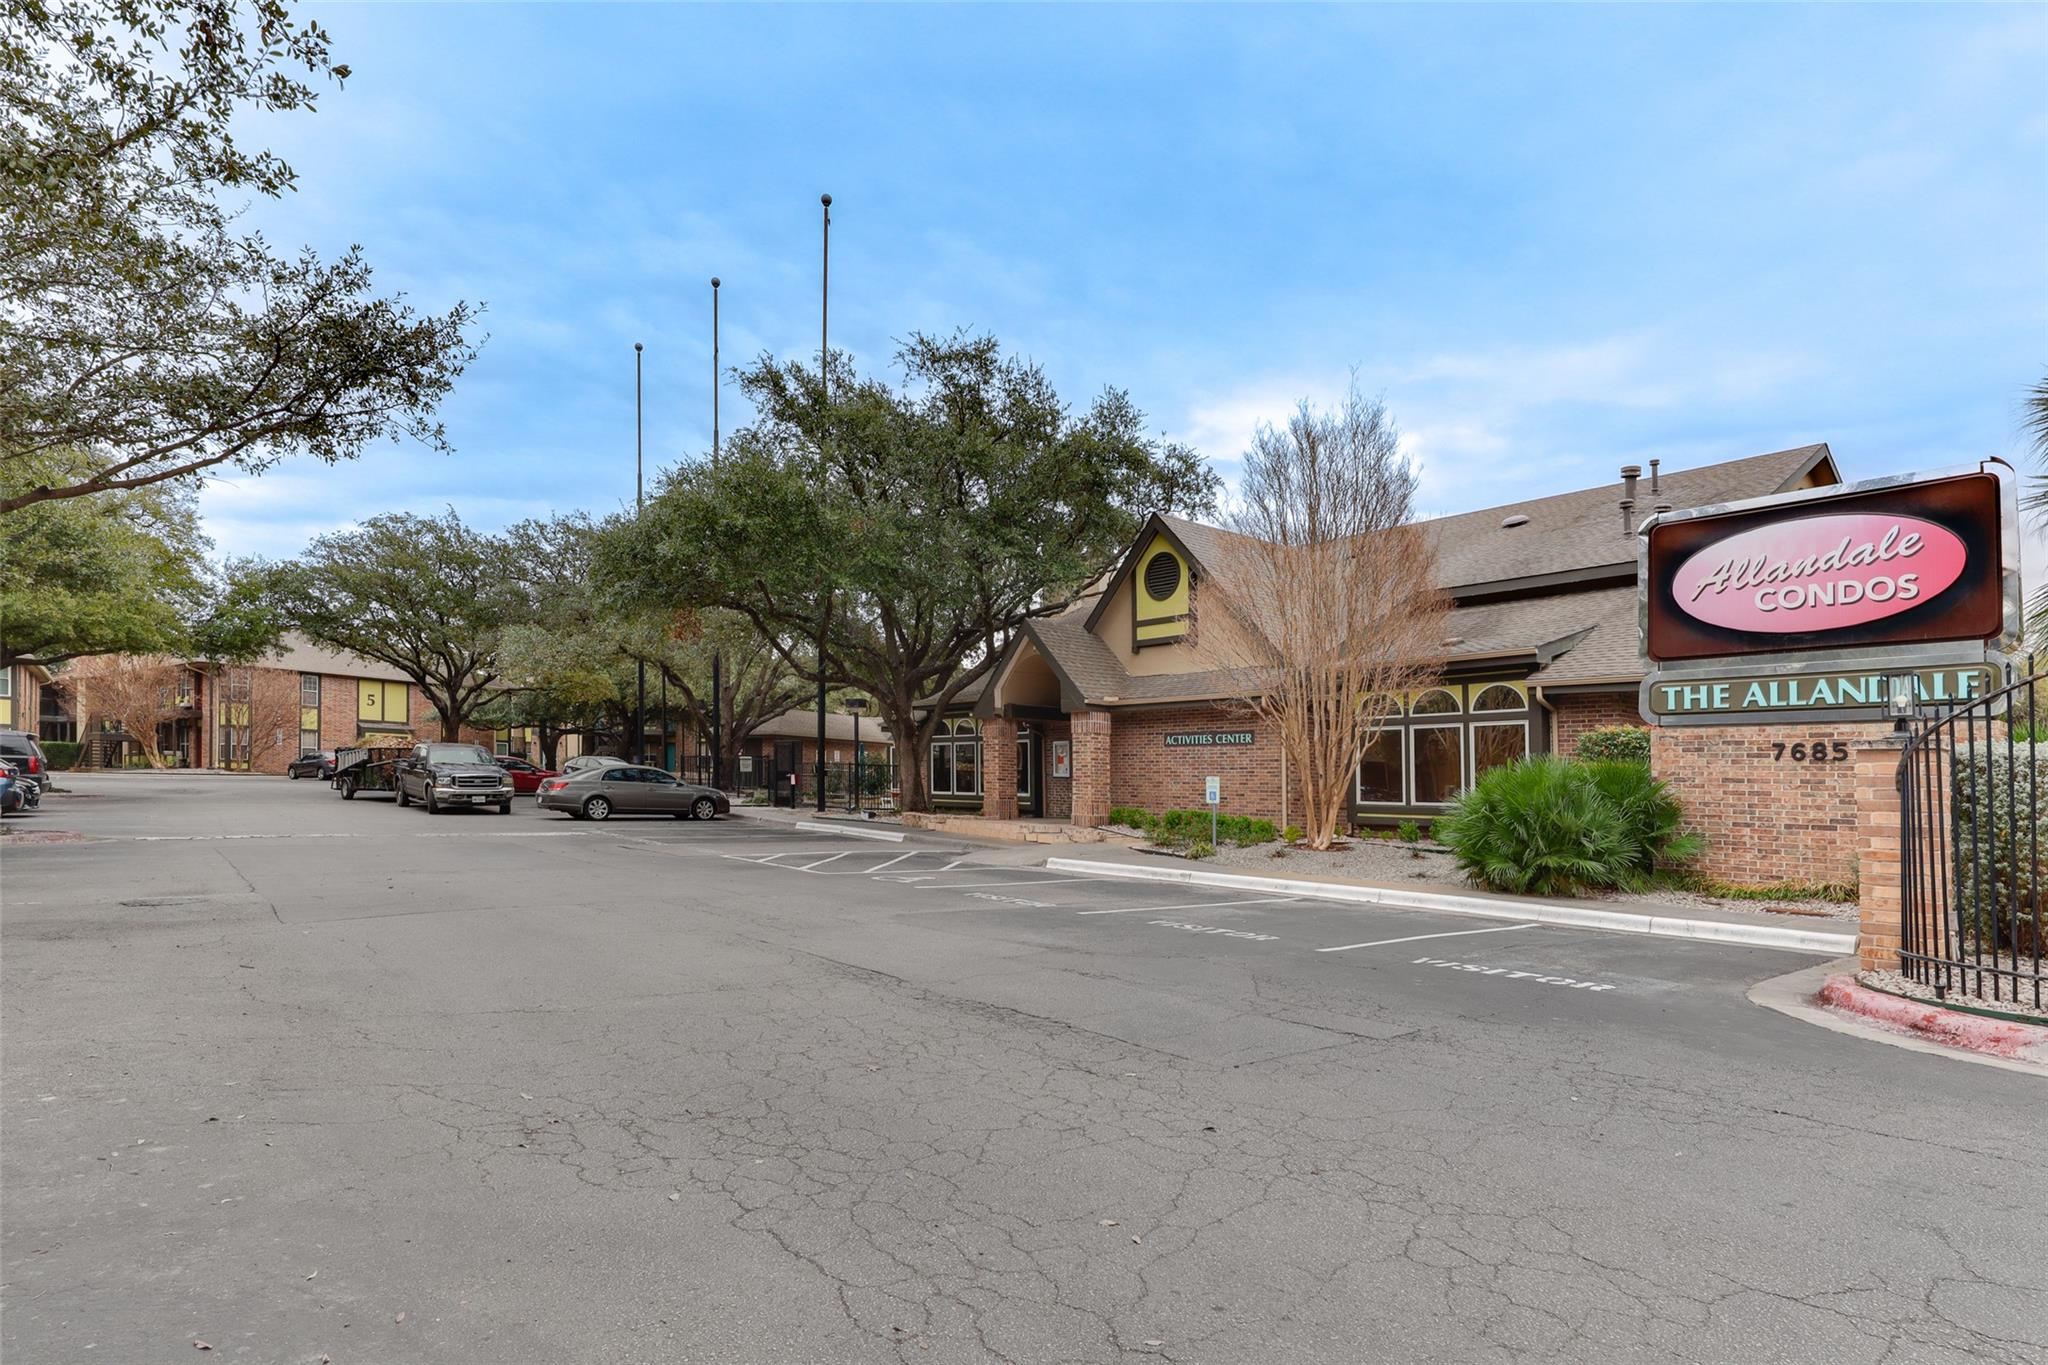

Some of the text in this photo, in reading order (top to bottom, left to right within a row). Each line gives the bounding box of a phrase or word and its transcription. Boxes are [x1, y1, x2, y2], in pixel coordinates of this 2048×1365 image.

[1692, 525, 1924, 602] Allandale
[1754, 573, 1920, 612] CONDOS
[366, 693, 376, 707] 5
[1661, 684, 1730, 711] THE
[1165, 733, 1252, 745] ACTIVITIES CENTER
[1772, 742, 1849, 762] 7685
[1146, 920, 1280, 941] VISITOR
[1410, 957, 1616, 992] VISITOR
